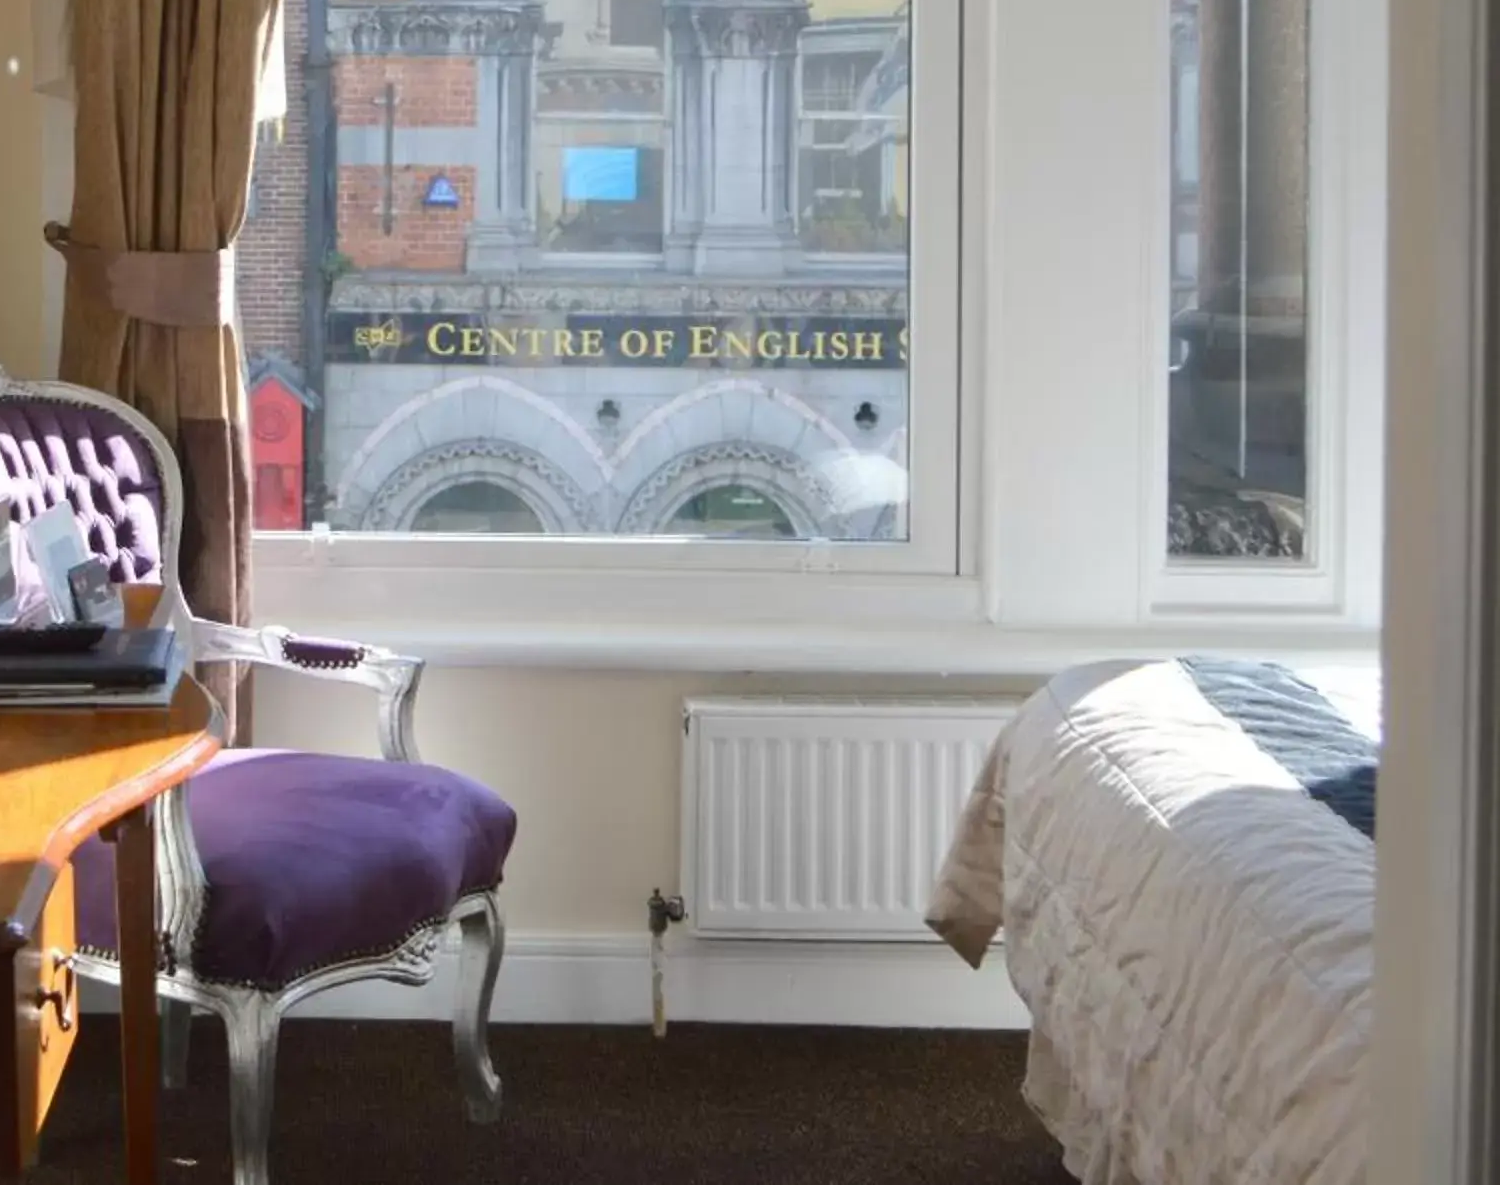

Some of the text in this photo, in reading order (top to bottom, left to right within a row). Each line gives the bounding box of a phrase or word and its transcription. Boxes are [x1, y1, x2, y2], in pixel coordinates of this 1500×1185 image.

[427, 322, 604, 357] CENTRE
[619, 329, 676, 358] OF
[688, 326, 883, 360] ENGLISH
